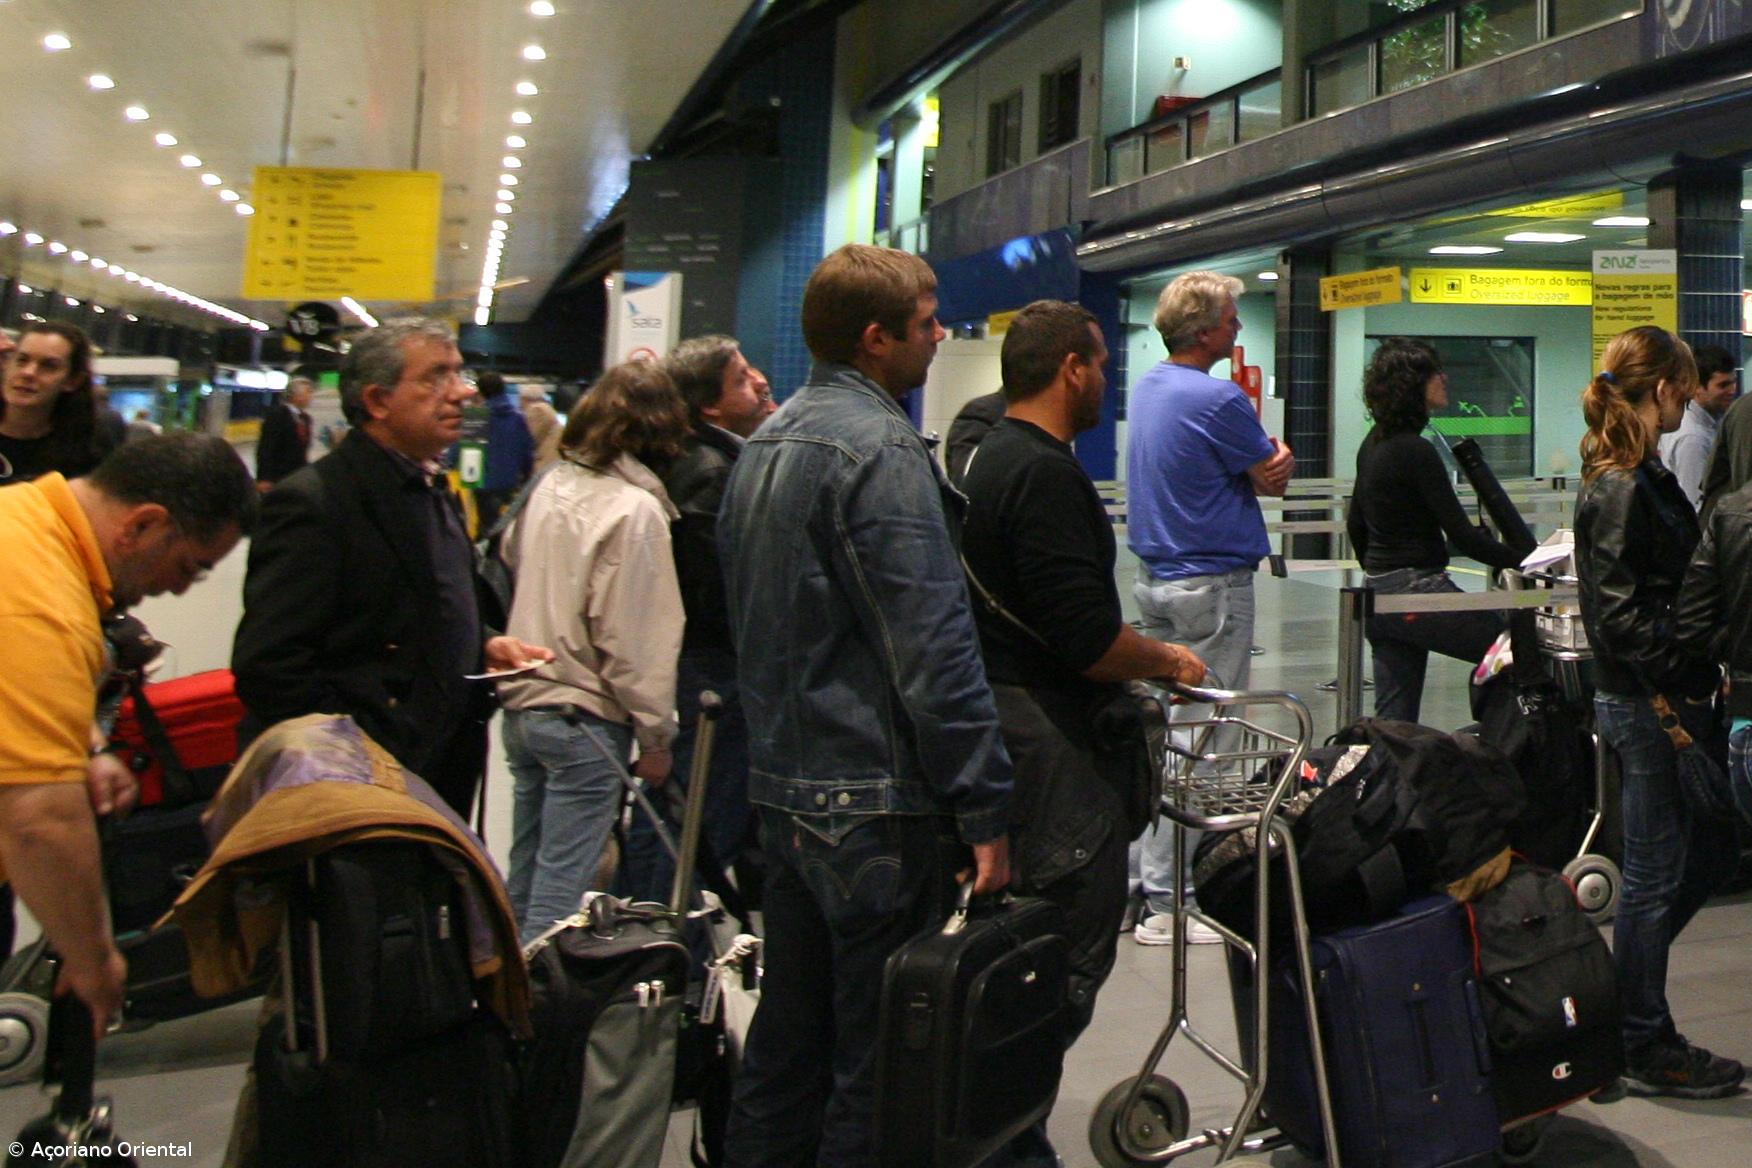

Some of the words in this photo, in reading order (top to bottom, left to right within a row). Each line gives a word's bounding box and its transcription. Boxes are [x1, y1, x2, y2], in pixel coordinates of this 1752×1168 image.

[1470, 275, 1522, 287] Bagagem
[1525, 275, 1546, 286] fora
[1549, 276, 1563, 286] do
[1527, 289, 1570, 302] luggage
[632, 318, 663, 329] sata
